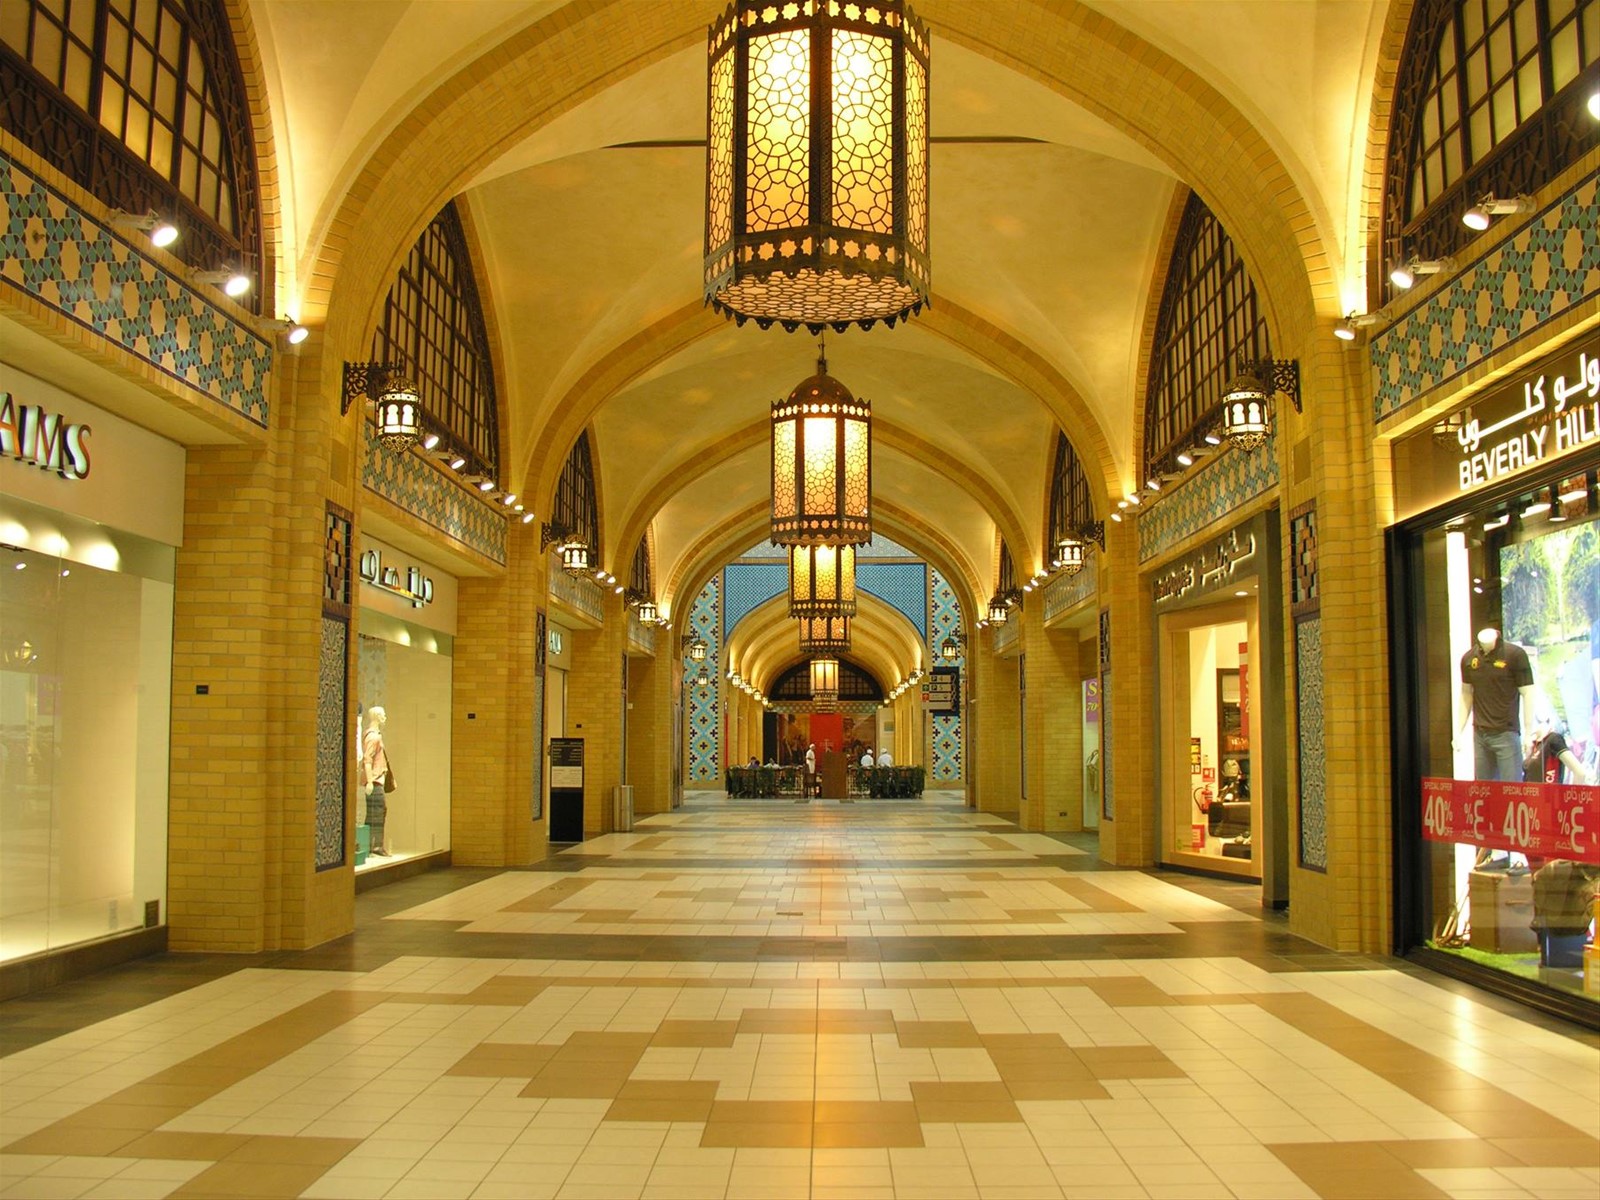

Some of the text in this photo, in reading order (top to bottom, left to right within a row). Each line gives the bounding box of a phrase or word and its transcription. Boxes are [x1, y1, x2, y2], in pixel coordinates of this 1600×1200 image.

[1458, 375, 1546, 453] كلوب
[1459, 425, 1548, 490] BEVERLY
[1424, 781, 1452, 791] SPECIAL OFFER
[1503, 785, 1540, 797] SPECIAL OFFER
[1424, 795, 1453, 836] 40%
[1503, 801, 1540, 848] 40%
[1528, 836, 1541, 849] OFF
